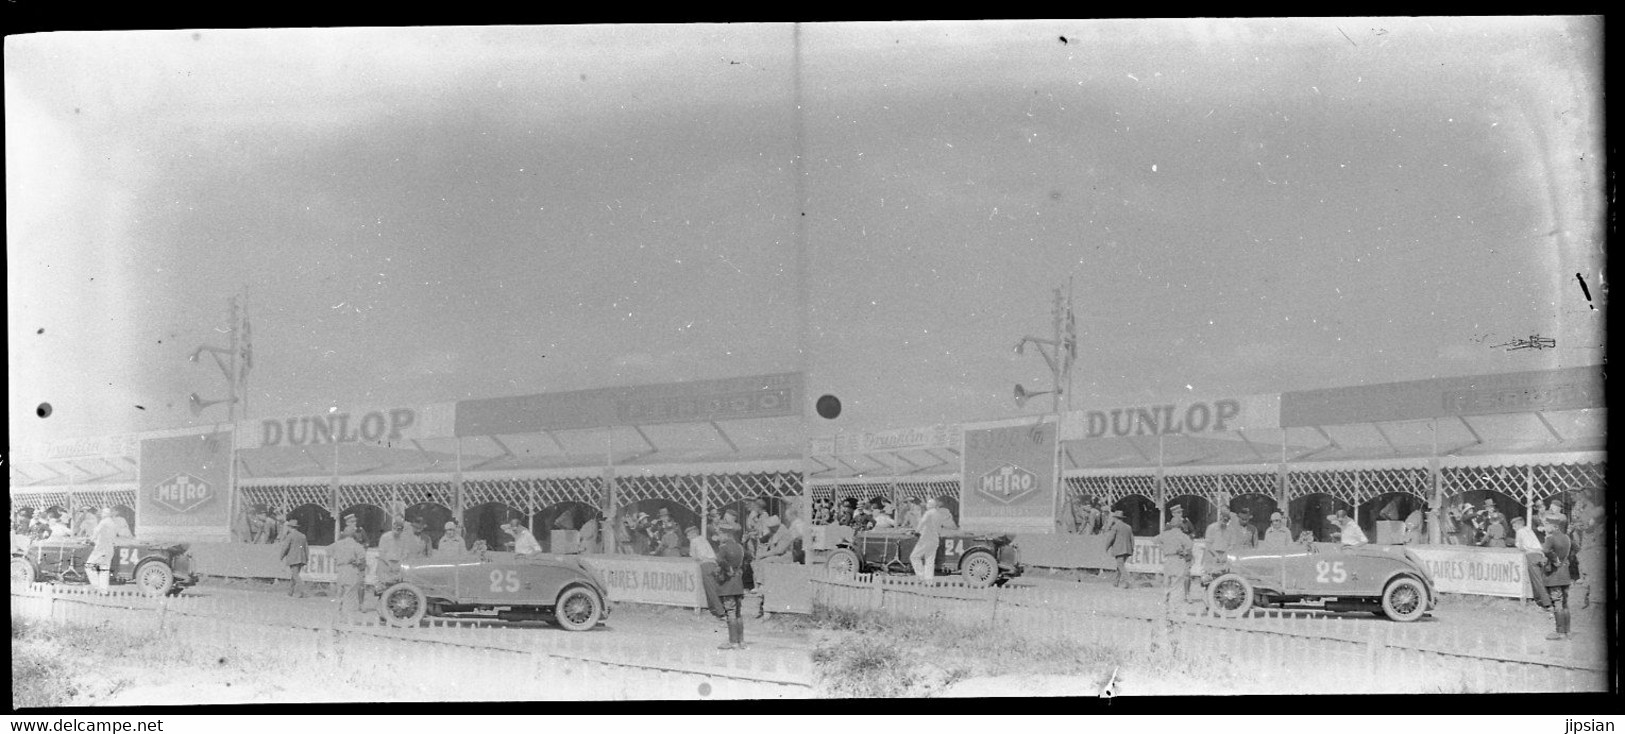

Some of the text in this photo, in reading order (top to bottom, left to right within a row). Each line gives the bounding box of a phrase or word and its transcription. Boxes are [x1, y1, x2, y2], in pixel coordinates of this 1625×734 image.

[261, 407, 416, 446] DUNLOP
[1085, 398, 1241, 438] DUNLOP
[158, 475, 208, 505] METRO
[983, 466, 1032, 496] METRO
[119, 547, 140, 566] 24
[944, 538, 965, 557] 24
[490, 569, 521, 592] 25
[641, 570, 696, 593] ADJOINTS
[1316, 560, 1348, 583] 25
[1467, 560, 1521, 583] ADJOINTS
